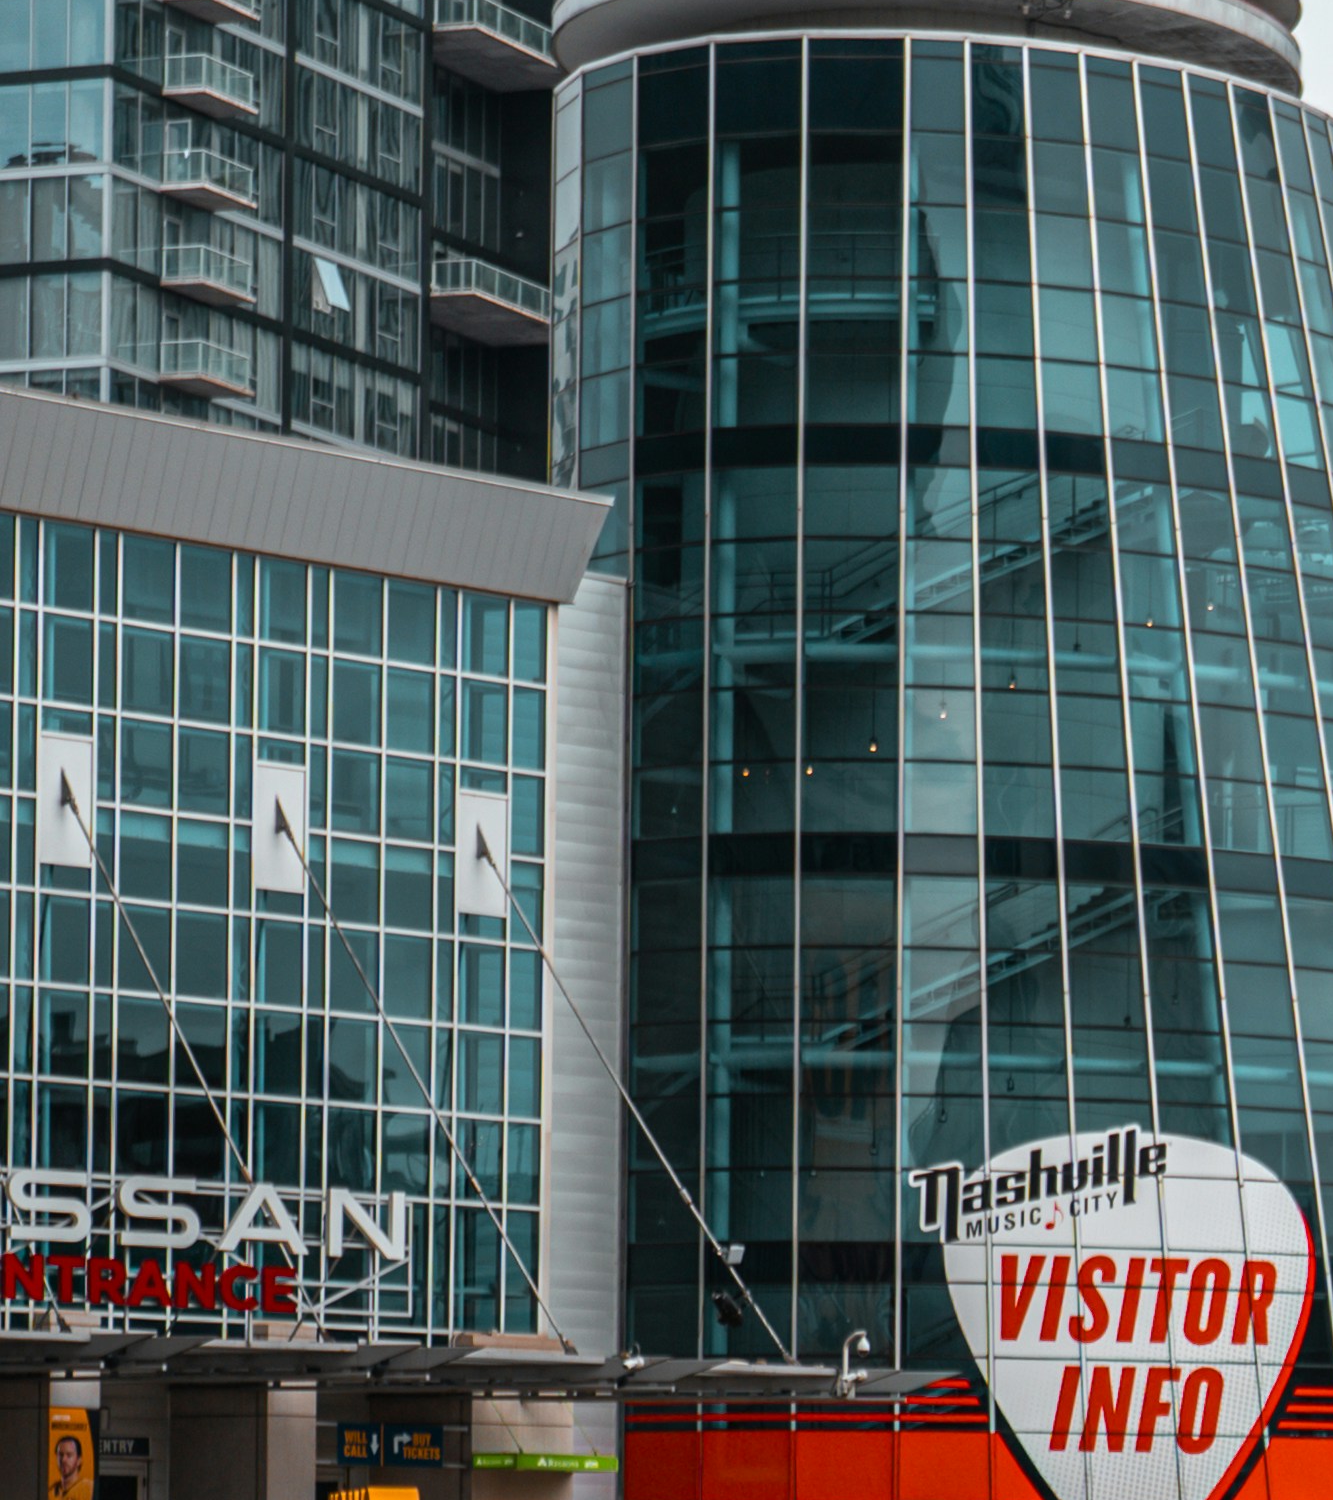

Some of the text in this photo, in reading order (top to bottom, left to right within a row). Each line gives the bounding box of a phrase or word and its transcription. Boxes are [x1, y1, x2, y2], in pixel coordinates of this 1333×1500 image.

[966, 1190, 1119, 1240] MUSIC CITY
[1000, 1254, 1277, 1347] VISITOR
[1049, 1365, 1225, 1455] INFO
[344, 1430, 368, 1444] WILL
[412, 1433, 432, 1447] BUY
[343, 1444, 368, 1458] CALL
[403, 1446, 441, 1460] TICKETS
